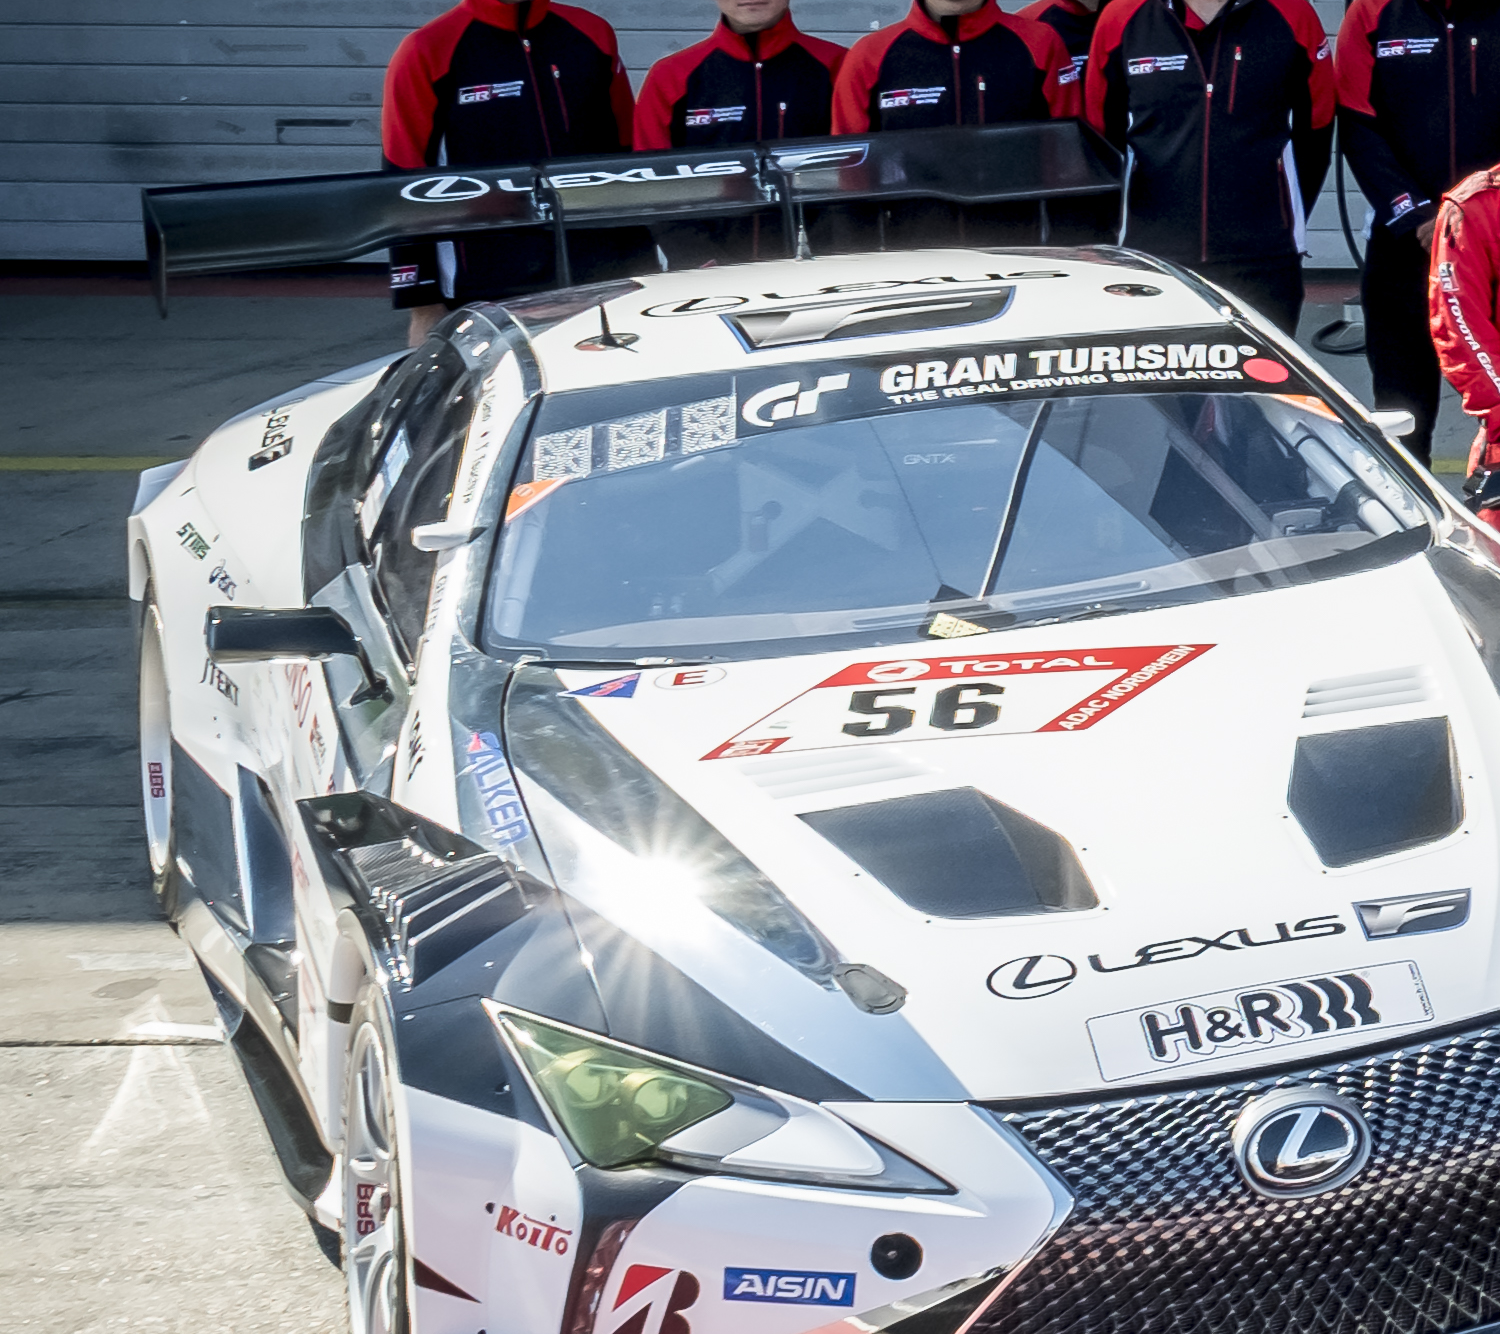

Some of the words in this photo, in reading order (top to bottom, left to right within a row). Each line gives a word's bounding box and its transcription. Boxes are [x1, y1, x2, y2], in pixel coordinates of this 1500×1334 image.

[499, 160, 745, 193] LEXUS
[761, 271, 1071, 301] LEXUS
[881, 354, 1019, 392] GRAN
[1031, 343, 1239, 373] TURISMO
[888, 391, 932, 406] THE
[942, 383, 991, 401] REAL
[1000, 375, 1106, 393] DRIVING
[1114, 368, 1242, 385] SIMULATOR
[940, 654, 1114, 676] TOTAL
[1058, 697, 1112, 730] ADAC
[1100, 643, 1195, 711] NORDRHEIN
[841, 683, 1005, 737] 56
[1088, 915, 1348, 973] LEXUS
[1142, 989, 1287, 1063] H&R
[733, 1275, 847, 1300] AISIN
